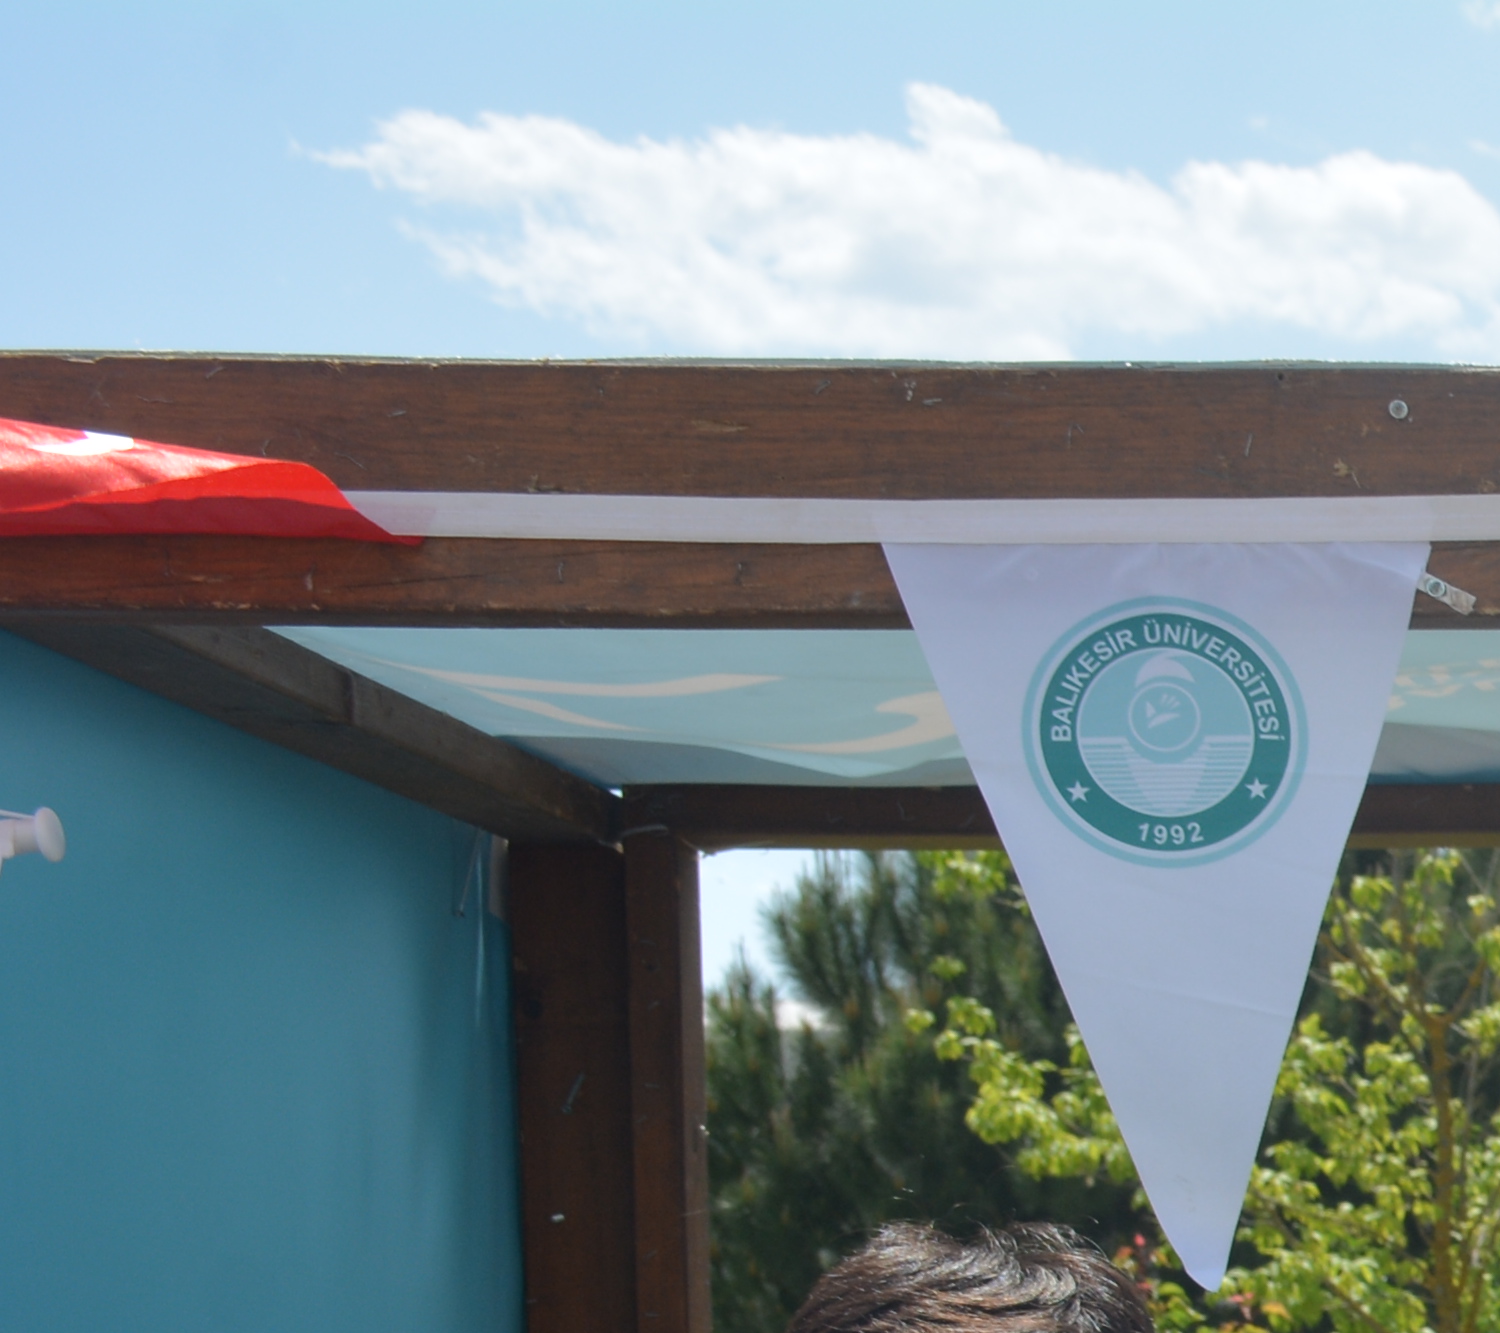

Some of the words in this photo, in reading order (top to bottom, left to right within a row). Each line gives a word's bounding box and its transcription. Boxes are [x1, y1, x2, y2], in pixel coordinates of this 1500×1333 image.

[1051, 628, 1136, 743] BALIKESİR
[1143, 619, 1286, 742] ÜNİVERSİTESİ
[1138, 821, 1205, 846] 1992
